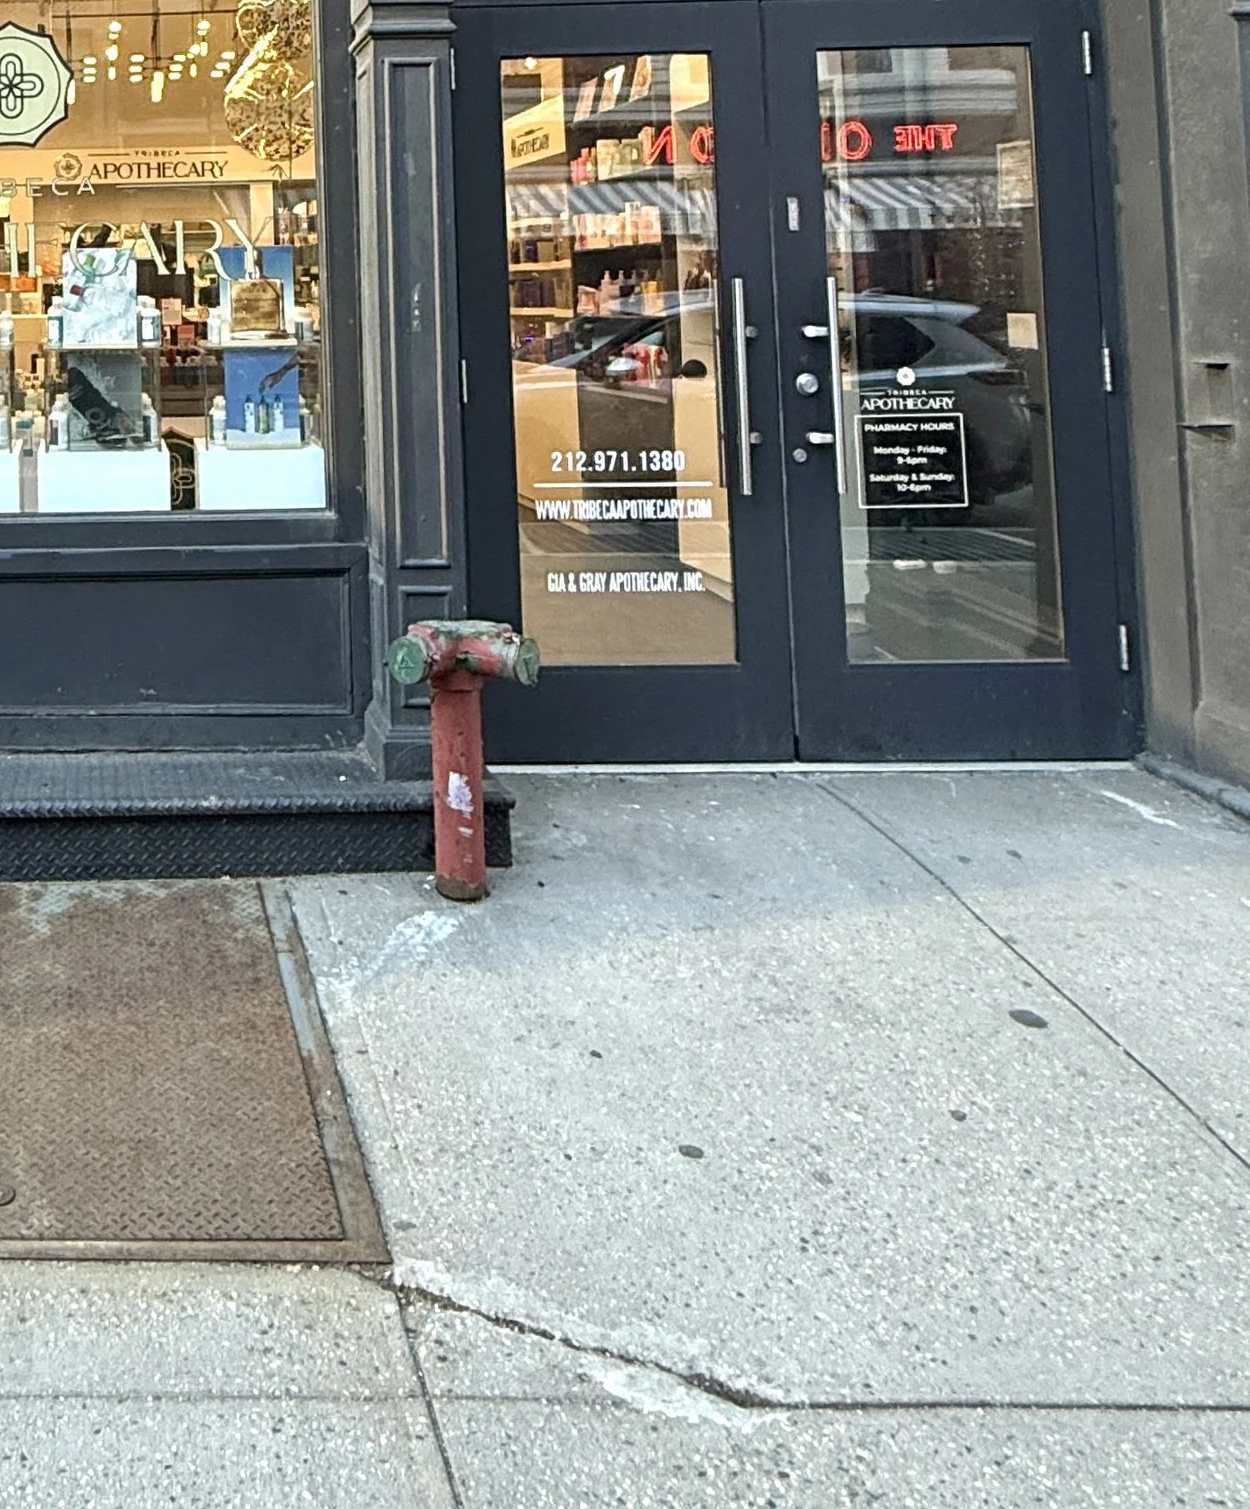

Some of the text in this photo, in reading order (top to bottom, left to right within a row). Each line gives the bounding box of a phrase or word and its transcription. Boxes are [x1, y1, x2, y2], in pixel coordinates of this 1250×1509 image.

[89, 160, 228, 179] APOTHECARY
[860, 396, 955, 410] APOTHECARY
[864, 422, 955, 432] PHARMACY HOURS
[873, 446, 910, 455] Monday
[551, 450, 686, 472] 212.971.1380
[869, 473, 909, 482] Saturday
[911, 473, 918, 481] &
[534, 498, 712, 520] WWW.TRIBECAAPOTHECARY.COM
[547, 572, 567, 592] GIA
[568, 572, 577, 592] &
[579, 572, 607, 592] GRAY
[683, 571, 706, 591] INC.
